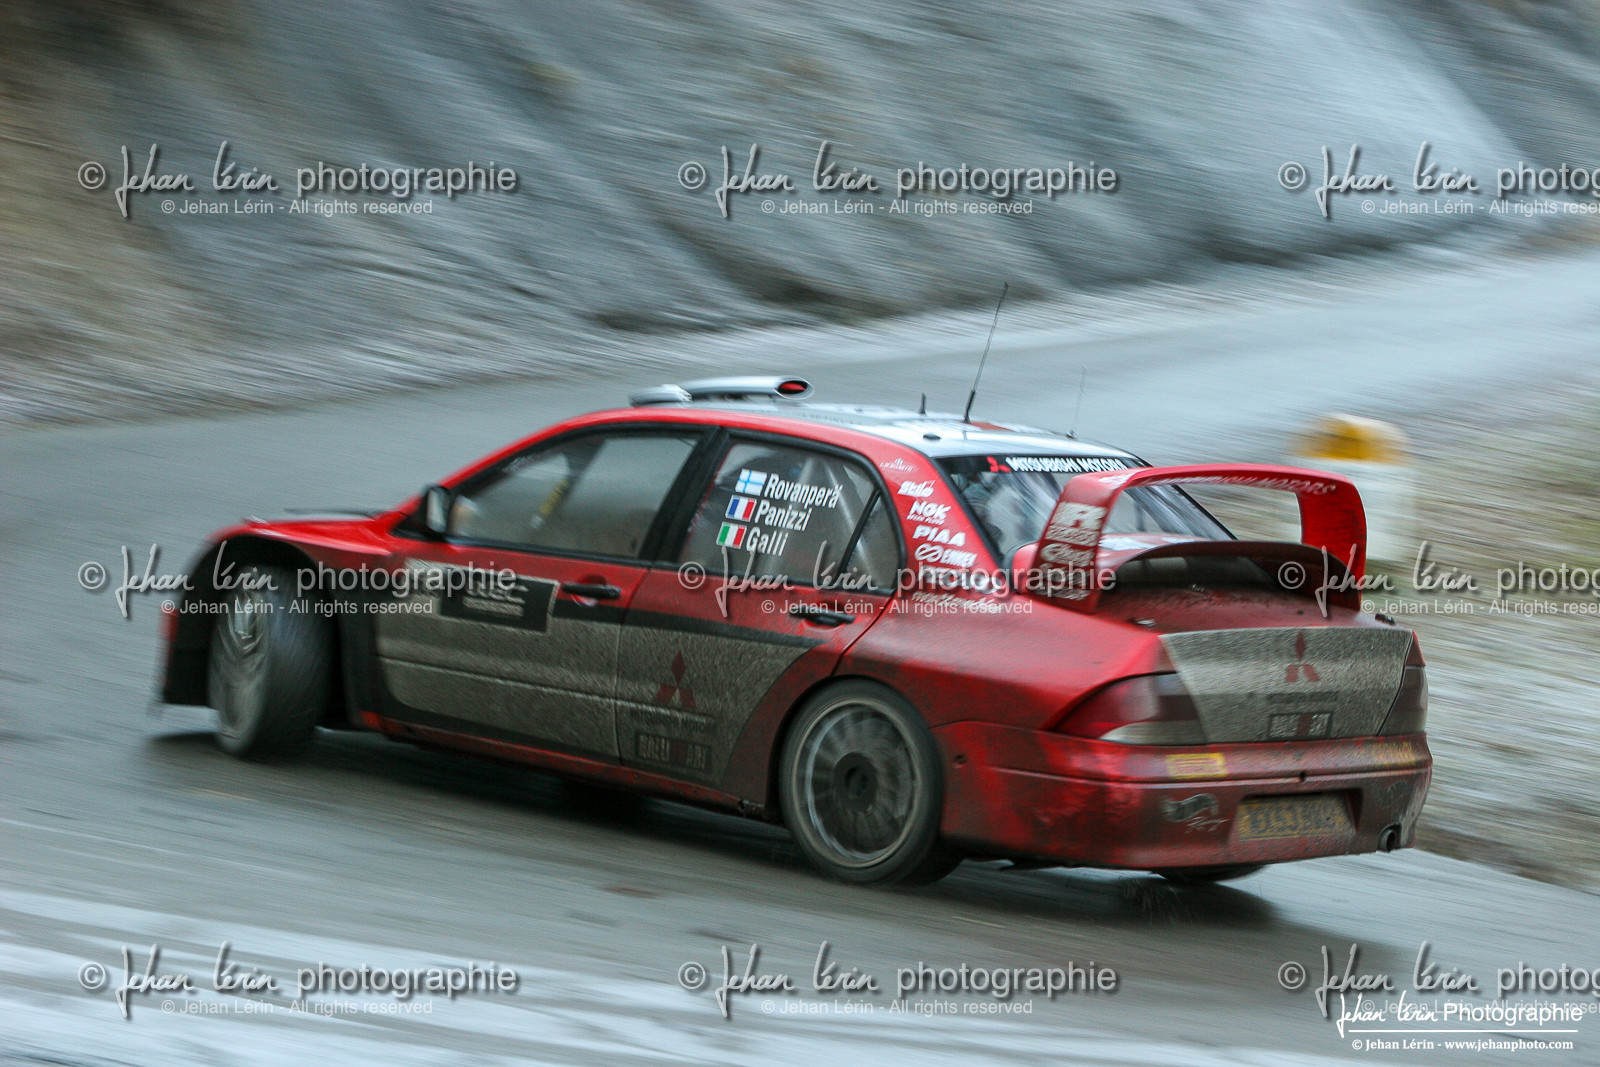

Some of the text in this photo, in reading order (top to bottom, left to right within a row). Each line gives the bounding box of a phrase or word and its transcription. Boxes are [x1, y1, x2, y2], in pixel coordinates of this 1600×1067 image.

[764, 473, 843, 509] Rovanperä
[755, 499, 812, 531] Panizzi
[908, 500, 952, 520] NGK
[746, 526, 788, 557] Galli
[912, 525, 966, 547] PIAA
